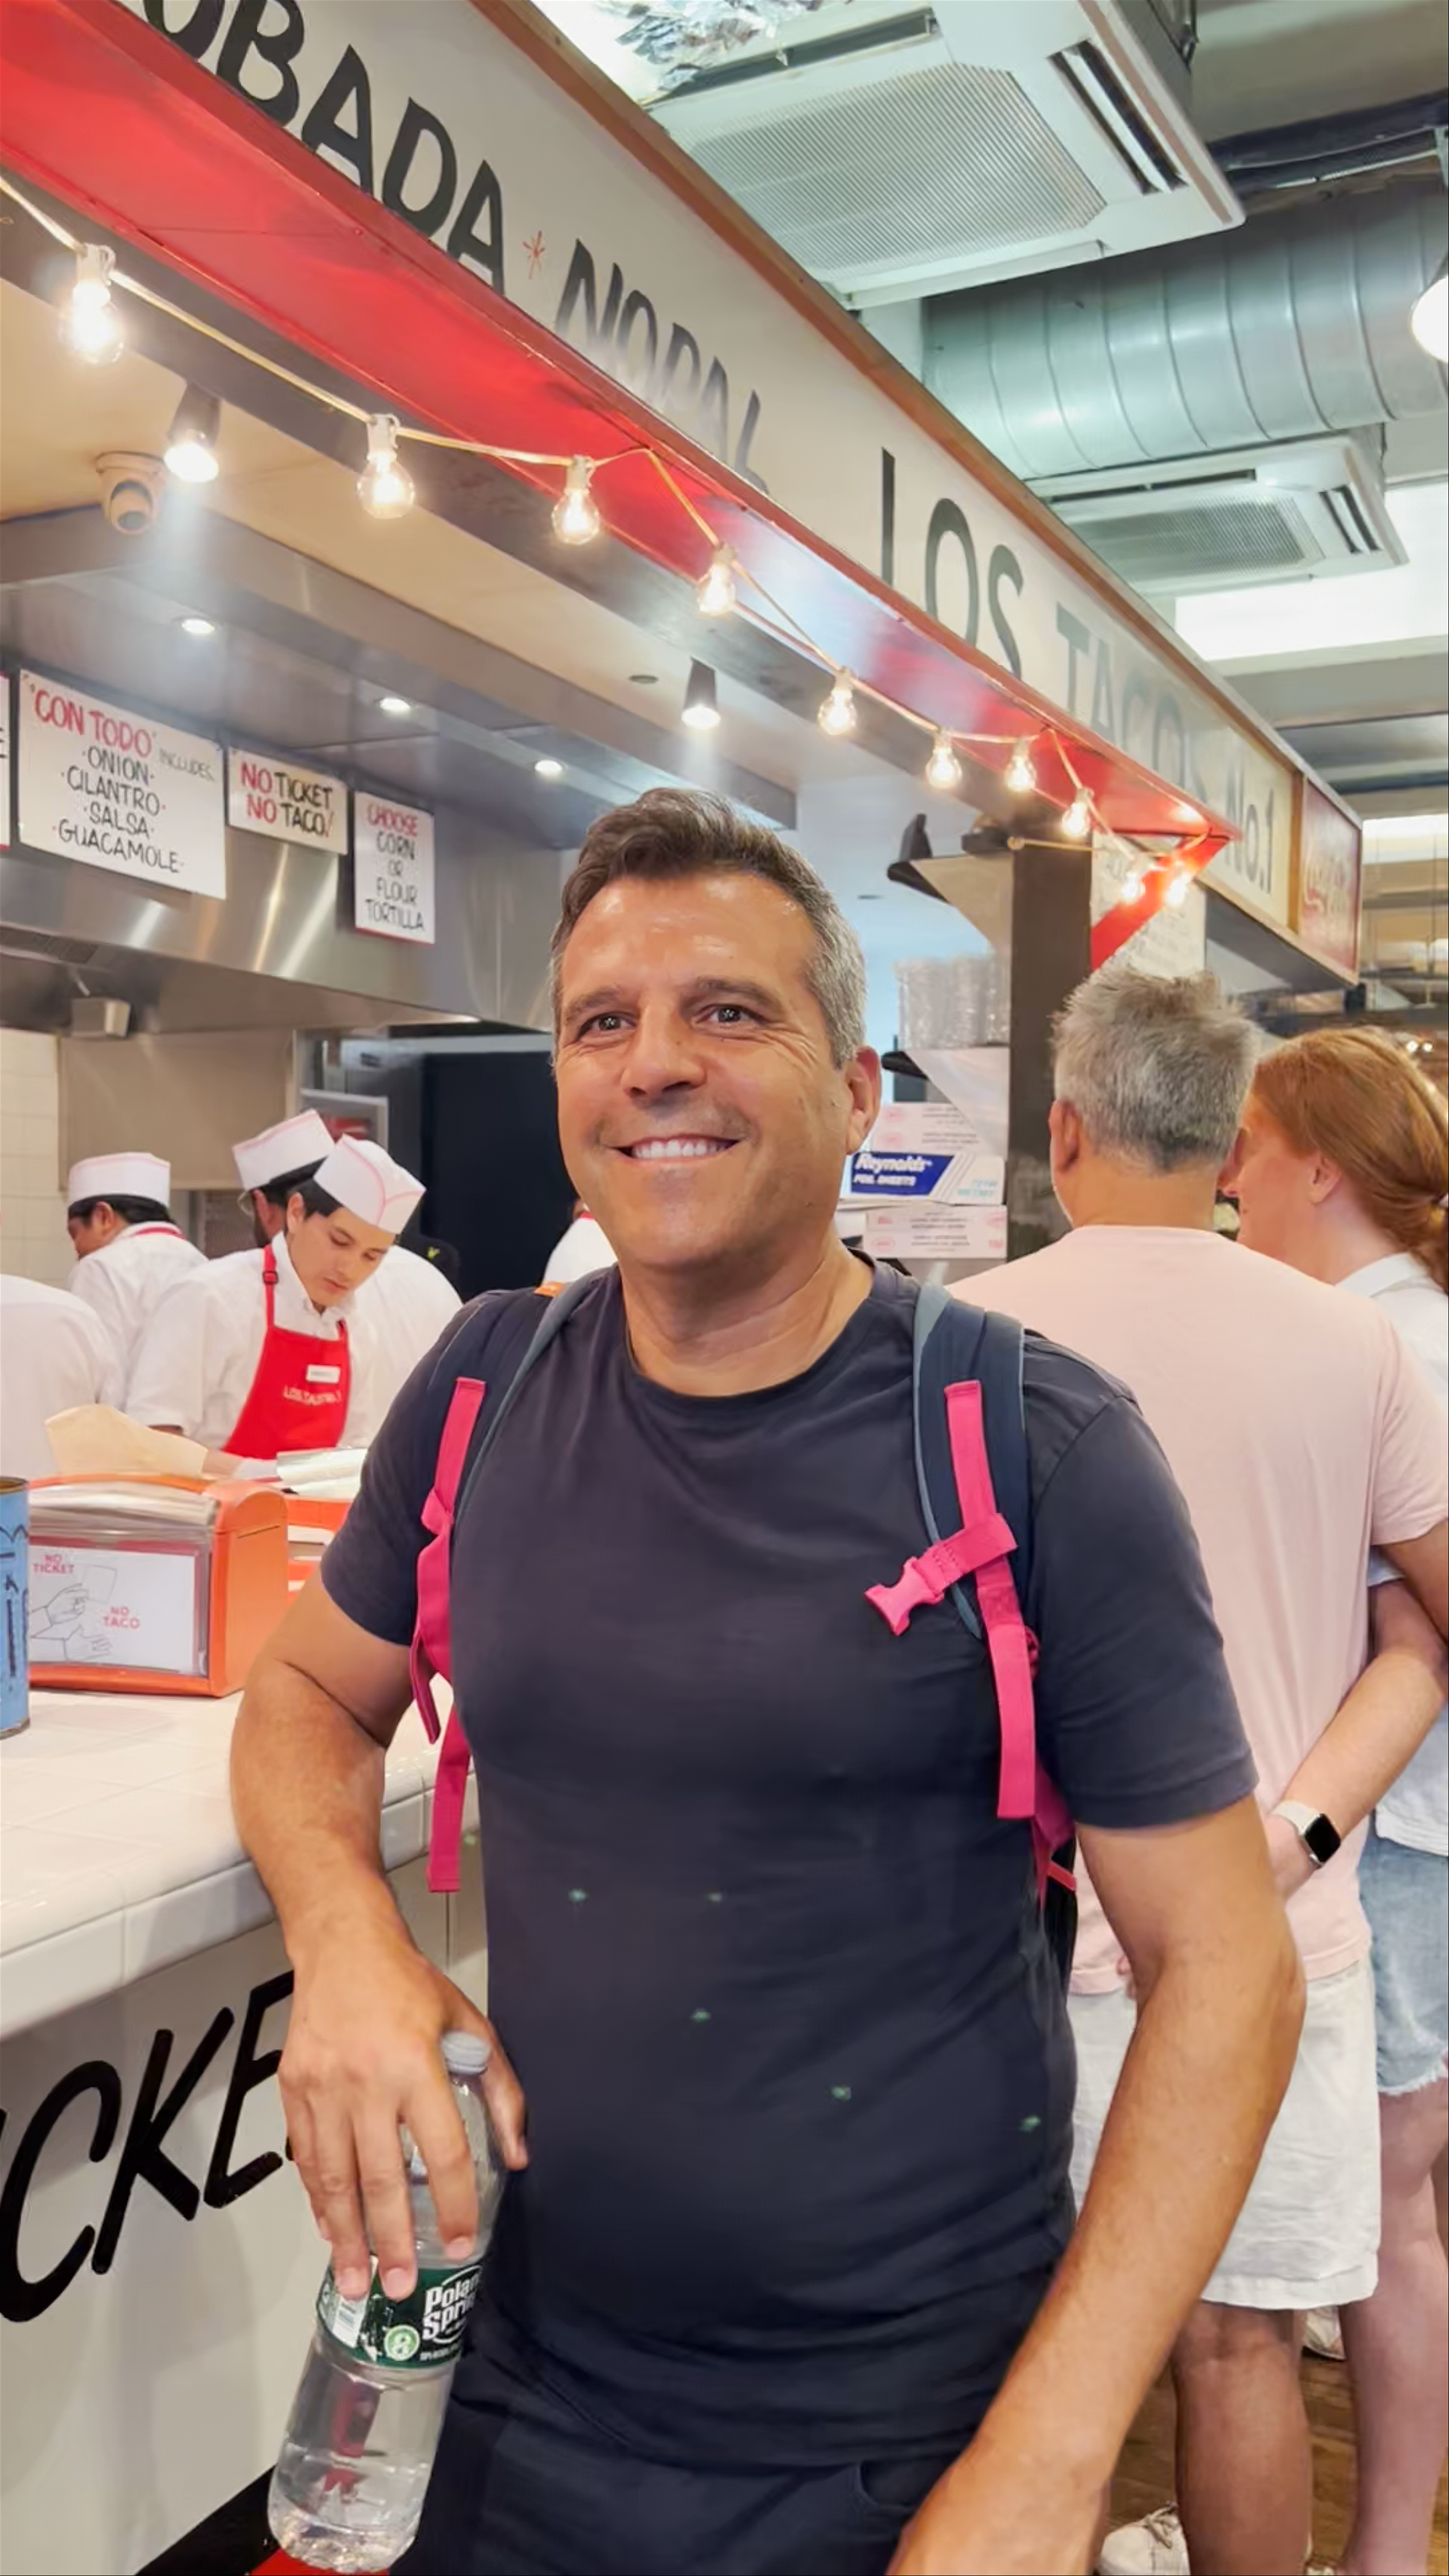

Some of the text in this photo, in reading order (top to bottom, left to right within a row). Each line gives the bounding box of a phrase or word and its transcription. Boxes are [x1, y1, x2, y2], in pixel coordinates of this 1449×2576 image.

[88, 746, 149, 787] ONION
[67, 765, 160, 817] CILANTRO
[241, 762, 333, 810] NO TICKET
[89, 801, 149, 840] SALSA
[246, 794, 277, 824] NO
[58, 819, 180, 873] GUACAMOLE
[377, 831, 415, 860] CORN
[377, 877, 417, 909] FLOUR
[364, 898, 425, 932] TORTILLA
[33, 1563, 75, 1574] TICKET
[44, 1553, 63, 1563] NO
[103, 1616, 140, 1629] TACO
[110, 1606, 129, 1616] NO
[0, 1969, 296, 2322] CKE
[424, 2272, 480, 2317] Polan
